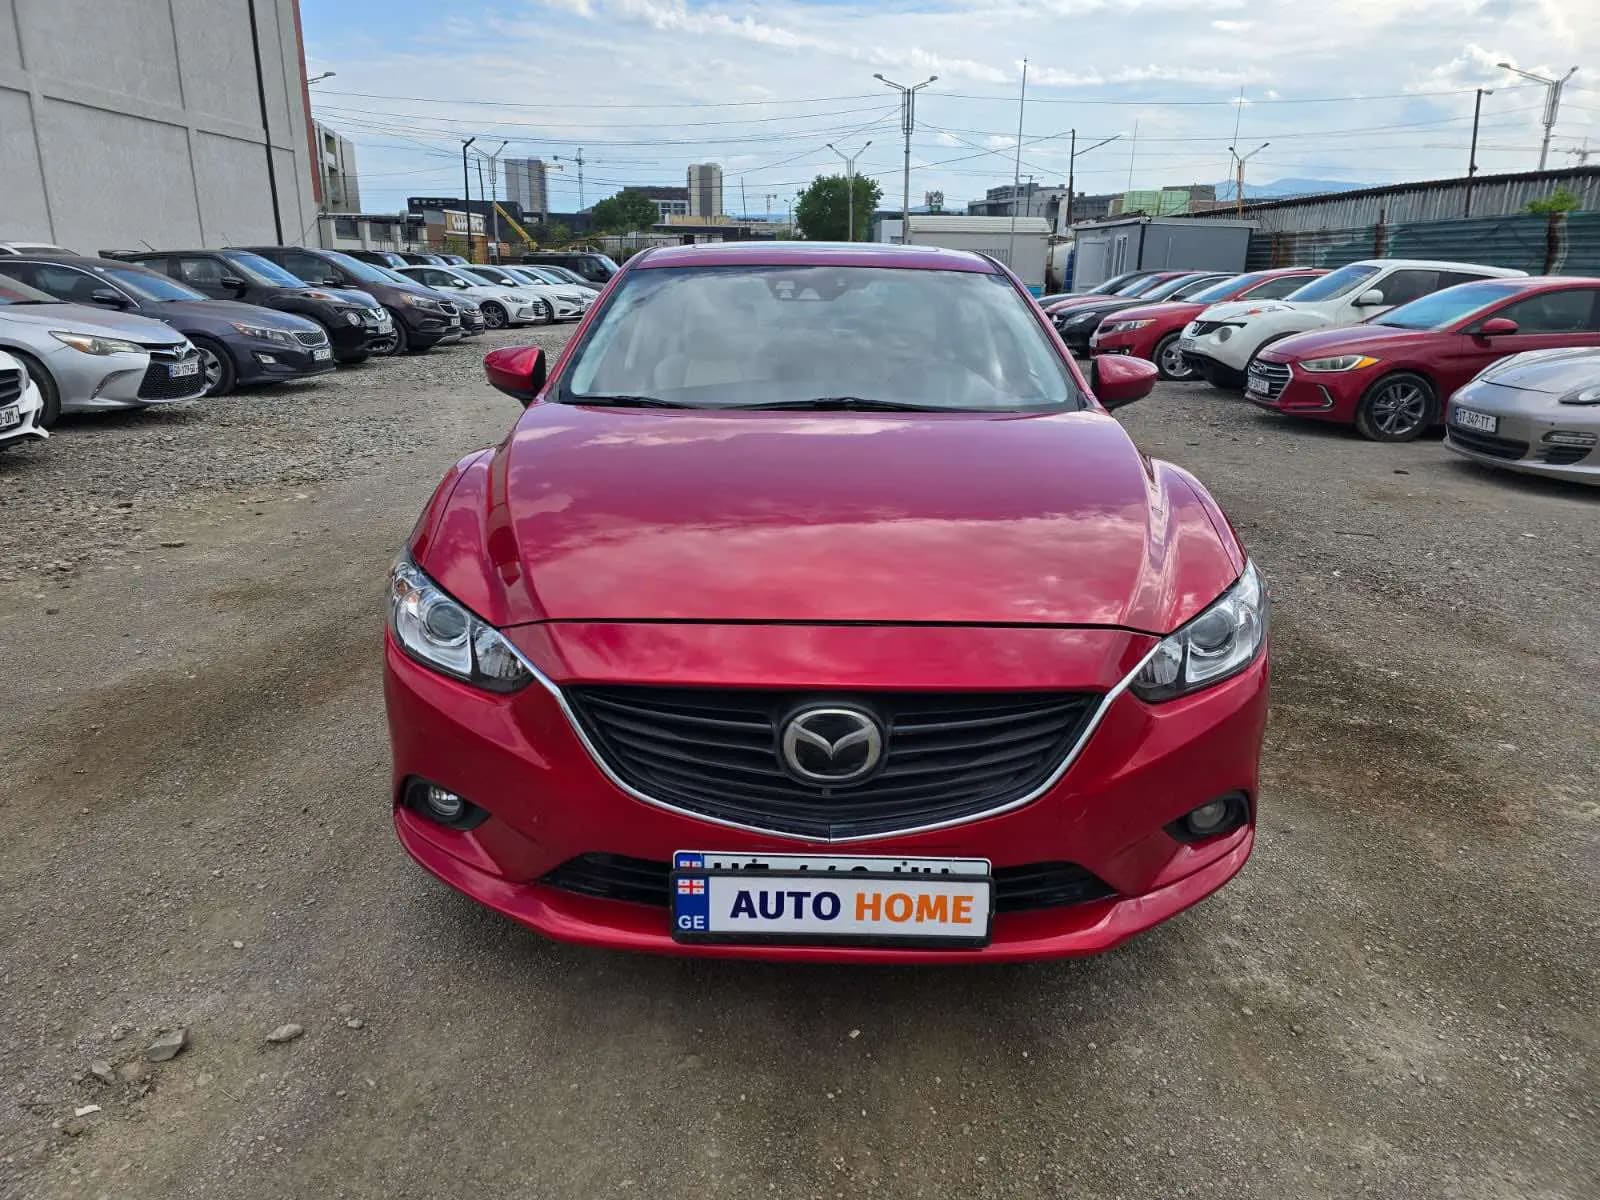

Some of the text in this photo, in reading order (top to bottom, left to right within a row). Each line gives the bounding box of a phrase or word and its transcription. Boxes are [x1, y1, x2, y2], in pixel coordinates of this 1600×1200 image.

[729, 890, 974, 924] AUTO HOME
[678, 915, 705, 930] GE
